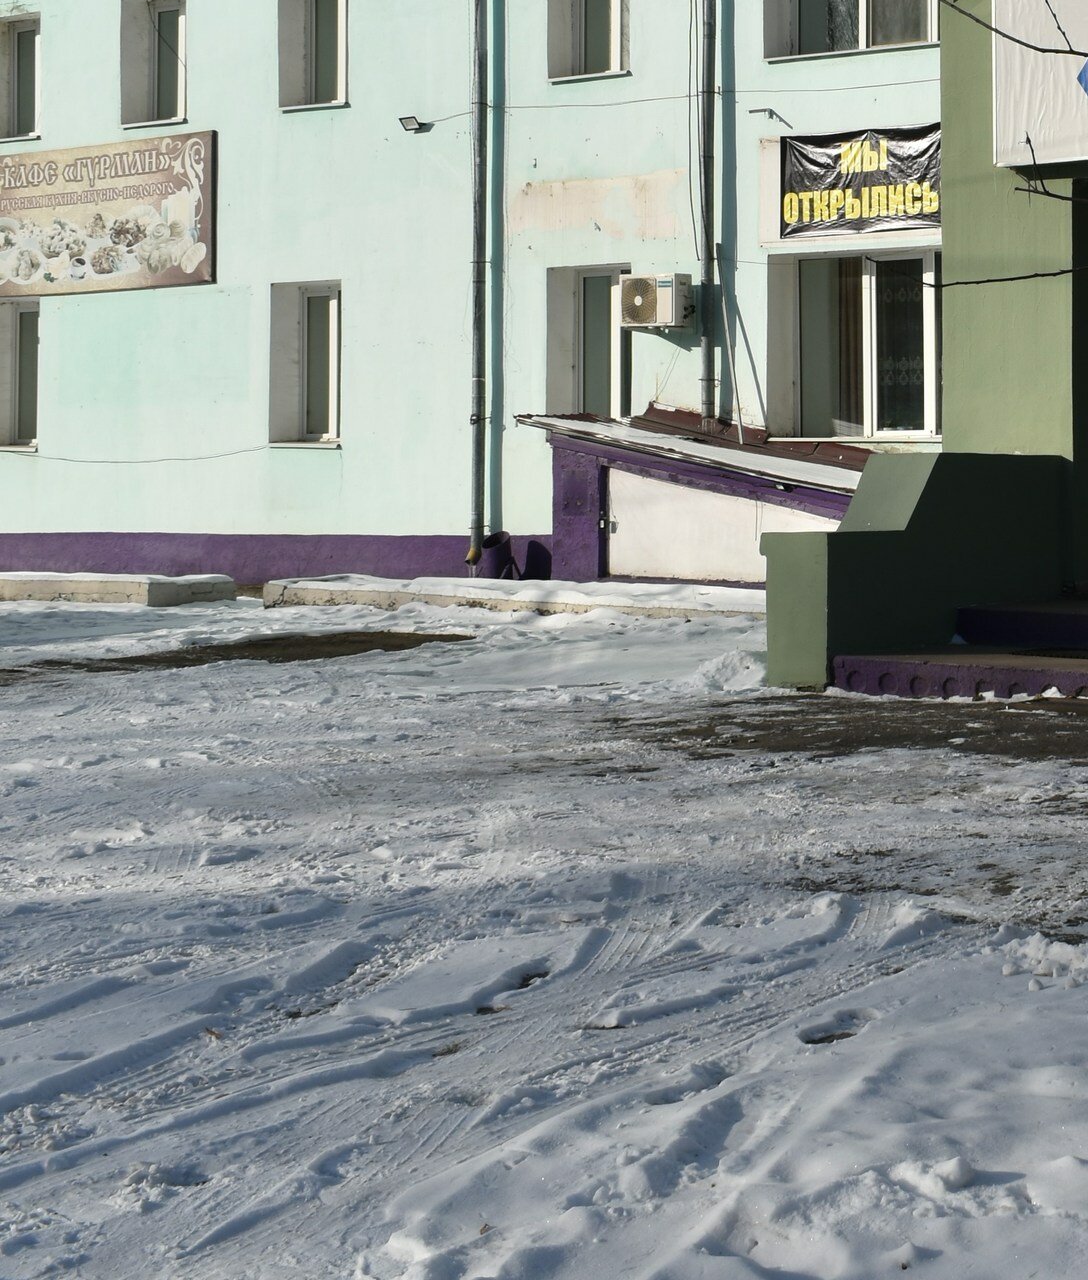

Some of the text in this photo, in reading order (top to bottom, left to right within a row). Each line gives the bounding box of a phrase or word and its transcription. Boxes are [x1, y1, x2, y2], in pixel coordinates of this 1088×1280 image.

[62, 150, 171, 187] «ГУРМАН»
[841, 138, 888, 174] МЫ
[783, 181, 939, 224] ОТКРЫЛИСЬ
